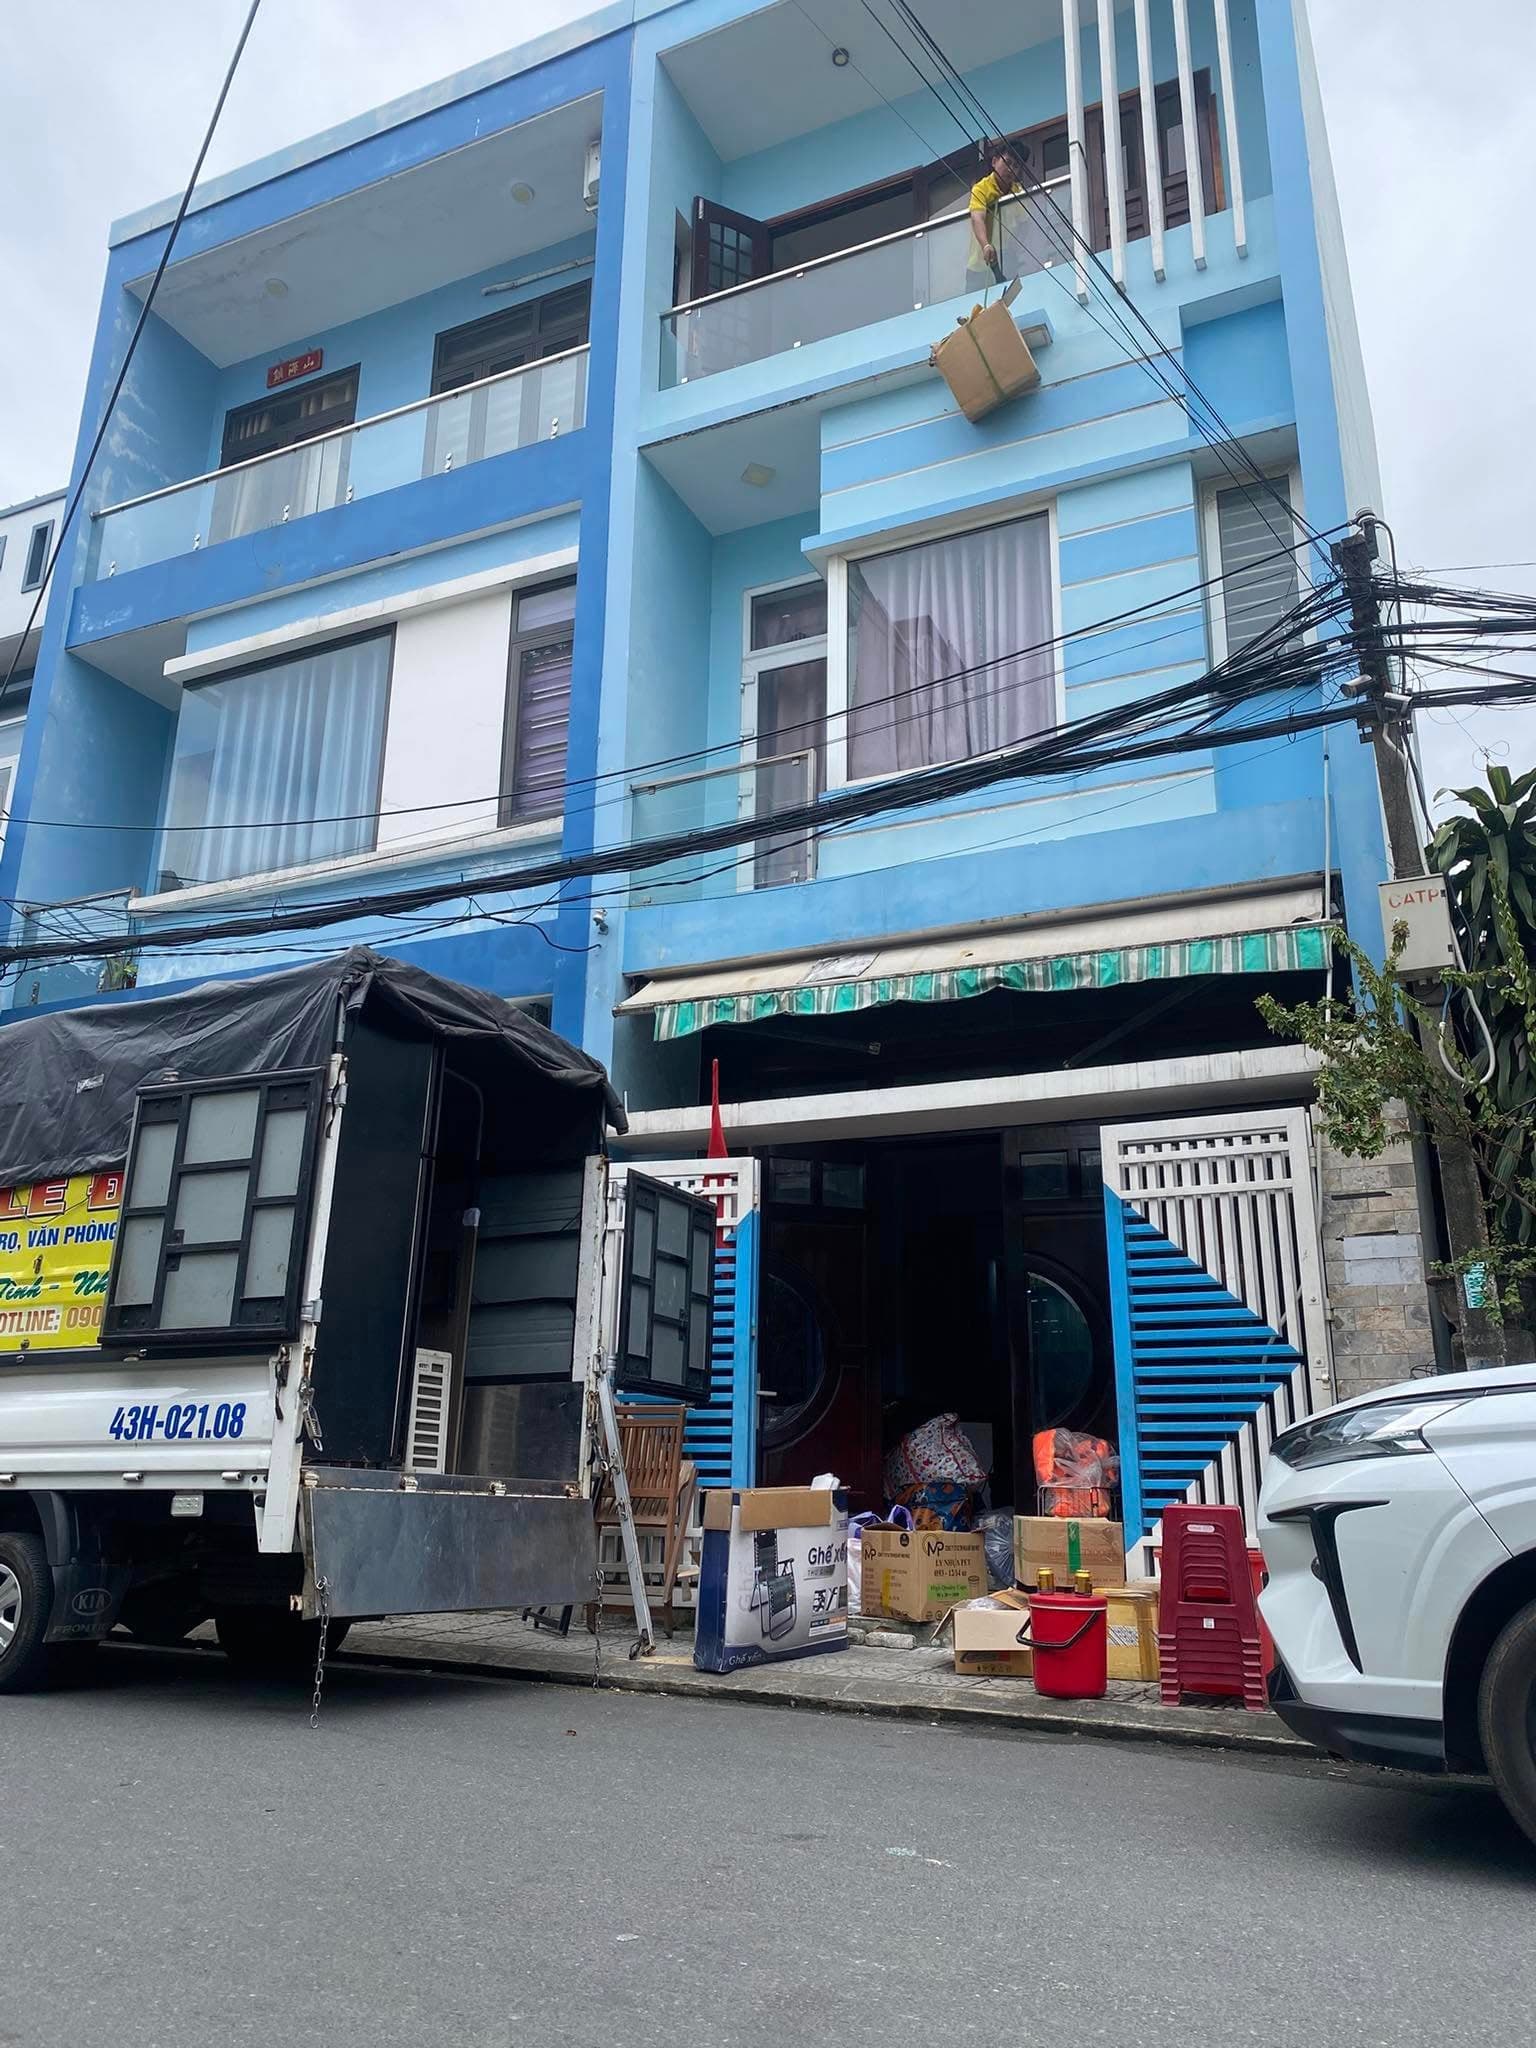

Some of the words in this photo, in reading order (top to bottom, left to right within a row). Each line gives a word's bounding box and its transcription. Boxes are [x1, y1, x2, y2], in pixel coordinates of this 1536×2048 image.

[1388, 888, 1440, 909] CATP
[28, 1224, 60, 1248] VĂN
[109, 1402, 247, 1440] 43H-021.08
[808, 1543, 834, 1565] Ghế
[79, 1594, 105, 1609] KIA
